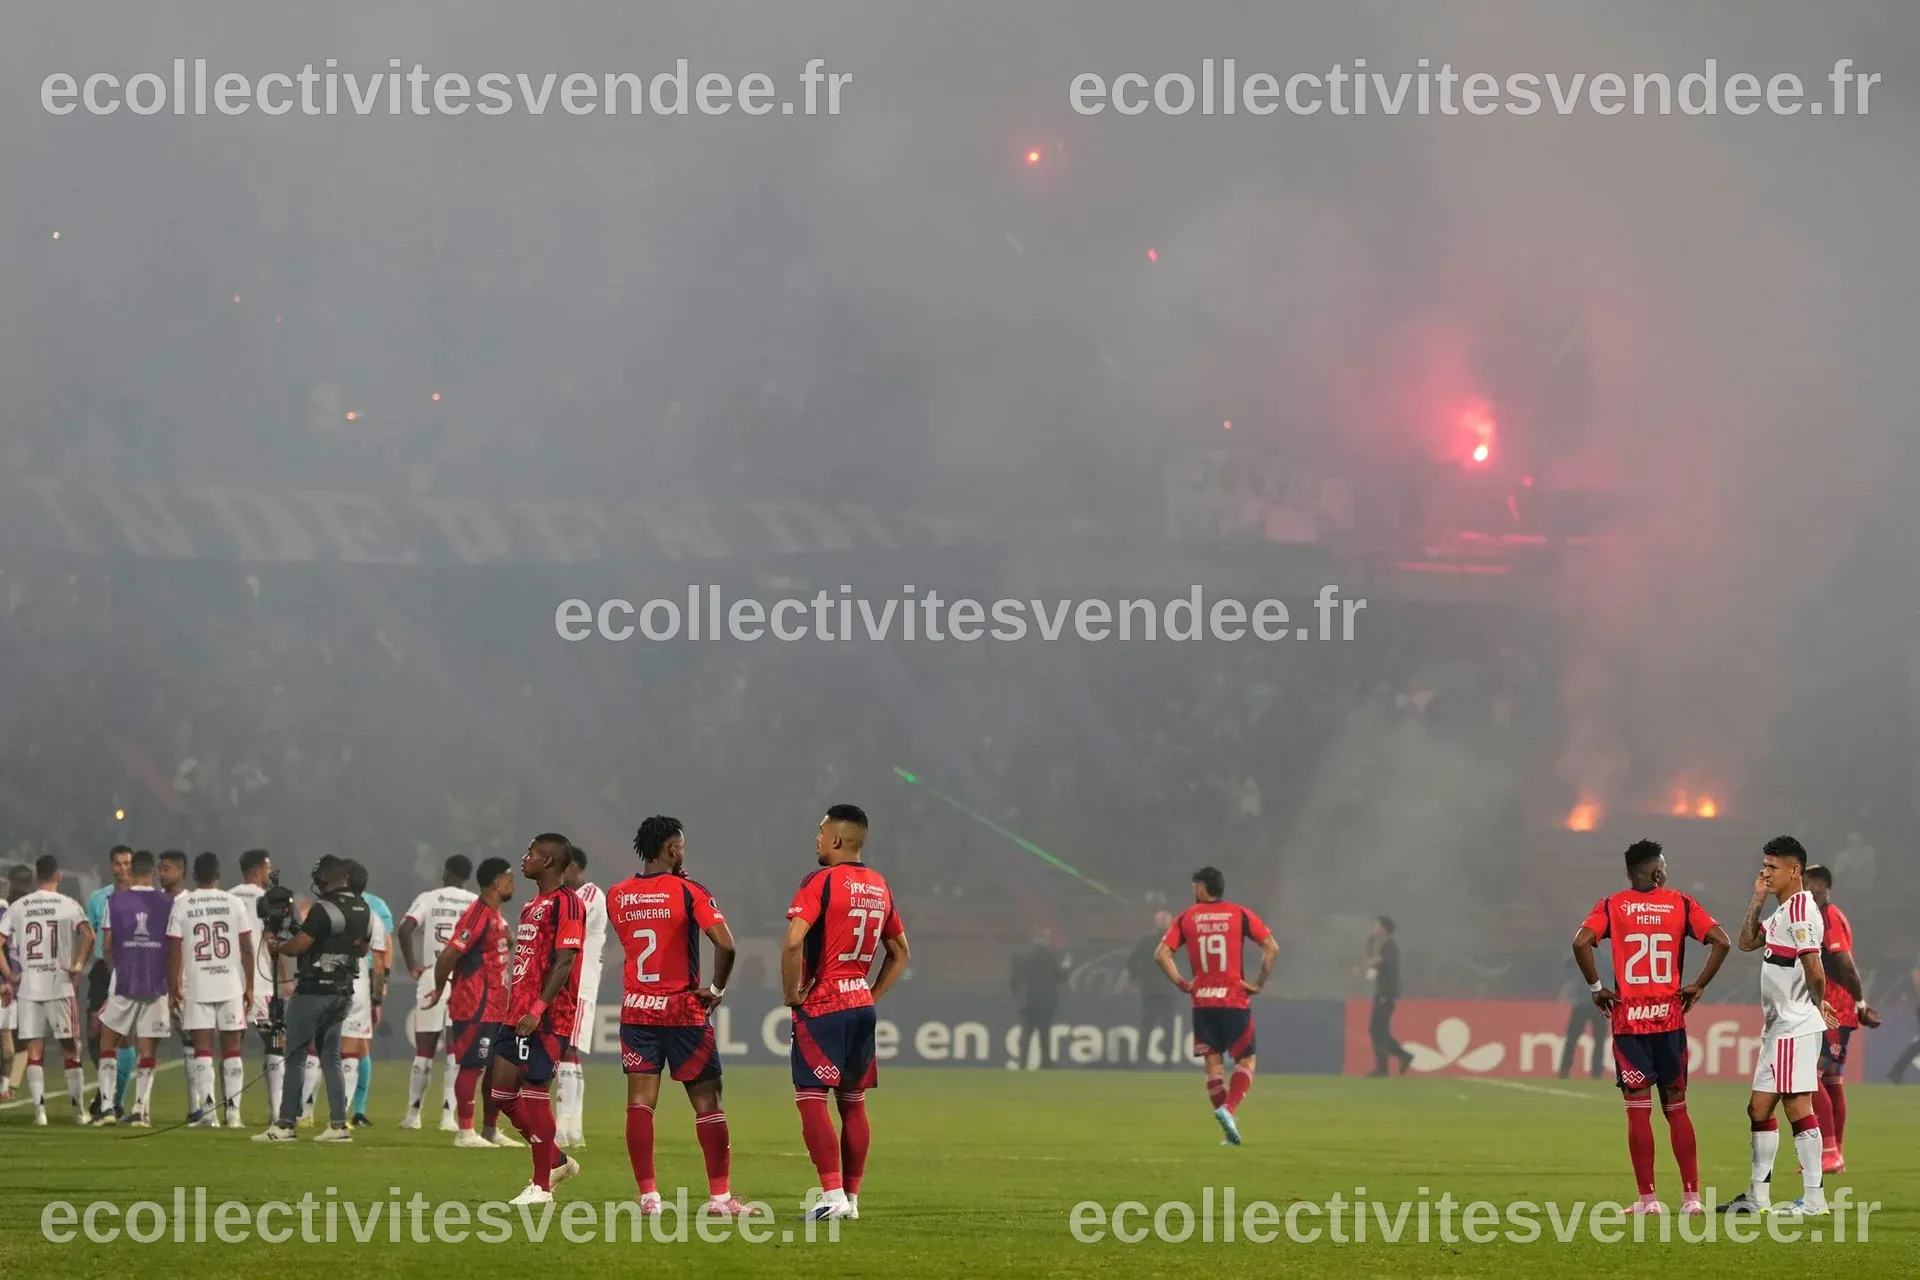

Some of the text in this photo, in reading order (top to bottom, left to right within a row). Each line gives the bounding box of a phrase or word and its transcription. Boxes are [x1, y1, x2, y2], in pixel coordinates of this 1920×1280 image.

[620, 893, 639, 909] JFK
[625, 908, 671, 921] CHAVERRA
[1627, 902, 1646, 916] JFK
[1636, 915, 1661, 925] MENA
[26, 921, 58, 960] 21
[193, 921, 231, 961] 26
[838, 908, 885, 962] 33
[1197, 934, 1227, 973] 19
[633, 928, 660, 983] 2
[1624, 934, 1673, 985] 26
[624, 993, 669, 1010] MAPEI
[1627, 1003, 1670, 1020] MAPEI
[915, 1020, 990, 1060] en
